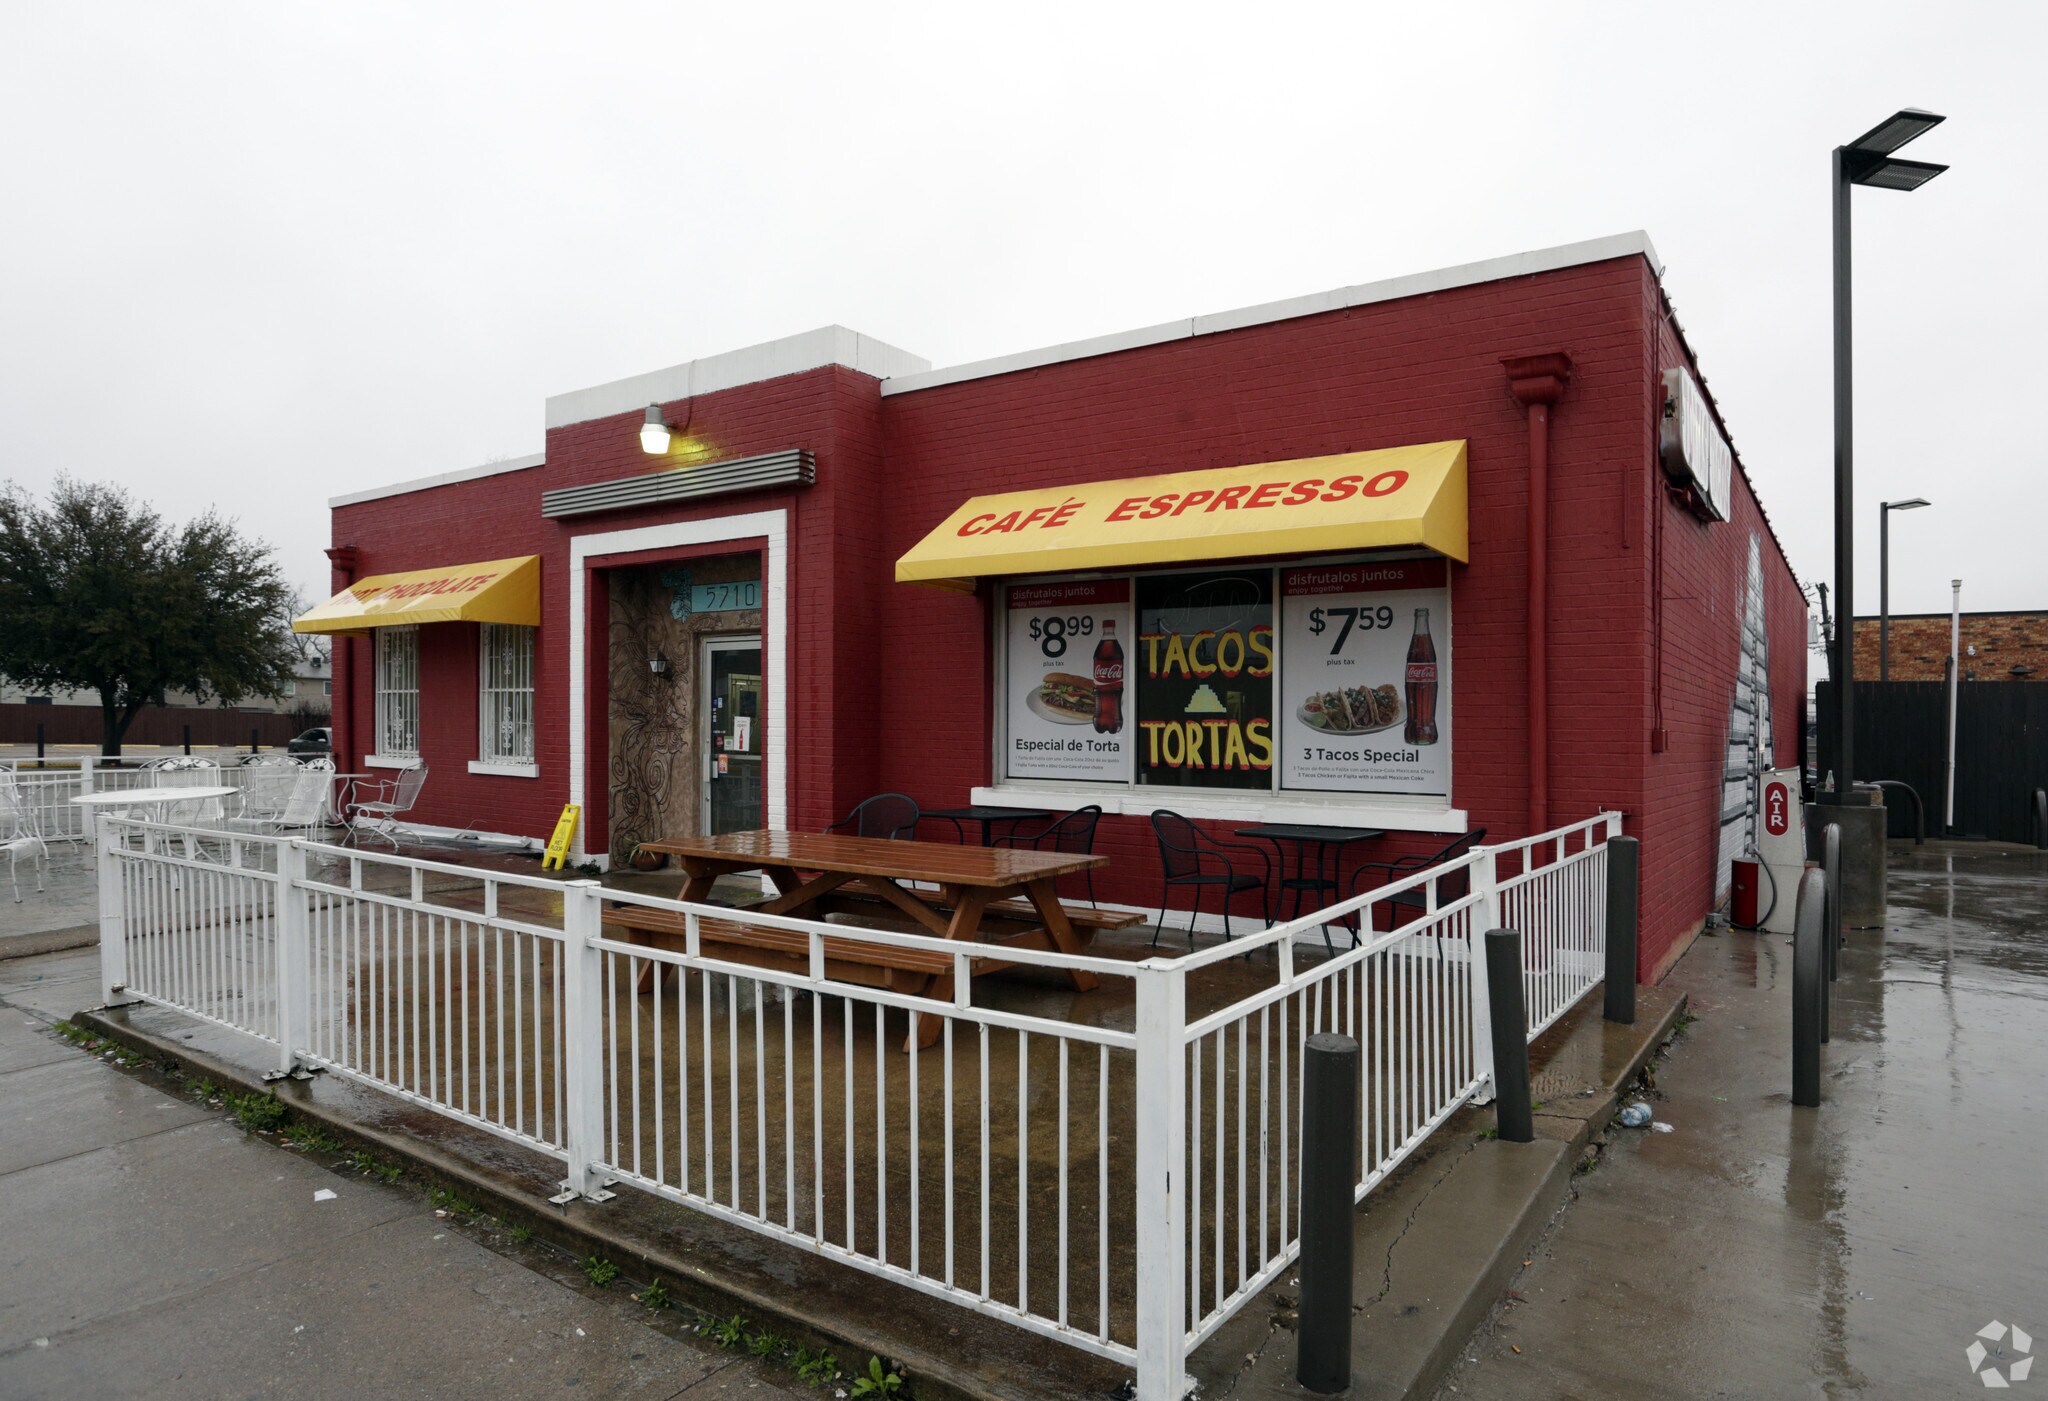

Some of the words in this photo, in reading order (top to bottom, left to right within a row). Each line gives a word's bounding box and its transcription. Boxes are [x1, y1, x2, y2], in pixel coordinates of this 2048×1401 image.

[957, 497, 1086, 537] CAFÉ
[1104, 470, 1410, 523] ESPRESSO
[373, 573, 498, 601] CHOCOLATE
[1288, 572, 1358, 586] disfrutalos
[1361, 569, 1404, 583] juntos
[1288, 587, 1308, 595] enjoy
[1310, 585, 1344, 593] together
[706, 583, 755, 608] 5710
[1012, 588, 1062, 600] disfrutalos
[1064, 586, 1095, 598] juntos
[1139, 624, 1272, 679] TACOS
[1016, 739, 1064, 752] Especial
[1067, 739, 1083, 751] de
[1086, 740, 1120, 752] Torta
[1140, 718, 1273, 770] TORTAS
[1304, 748, 1312, 760] 3
[1316, 748, 1359, 761] Tacos
[1363, 749, 1419, 764] Special
[1770, 789, 1784, 827] AIR
